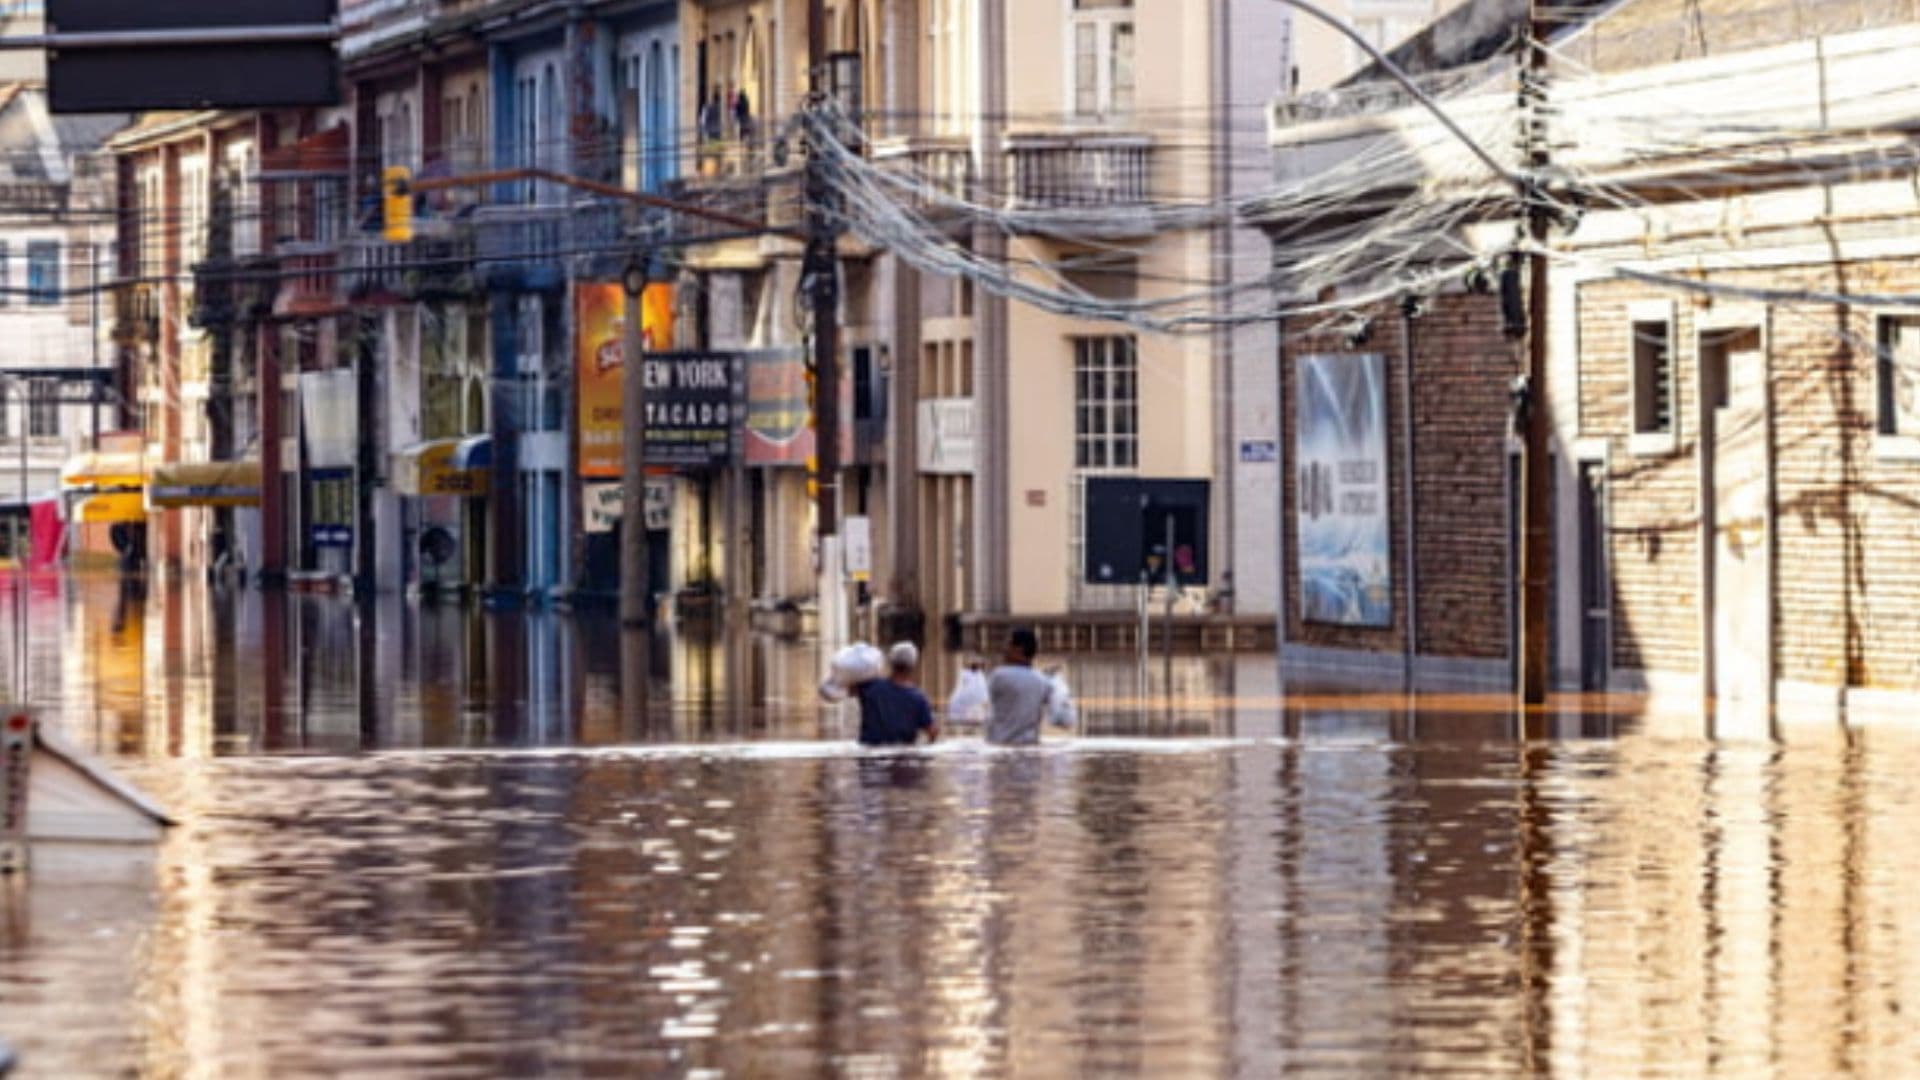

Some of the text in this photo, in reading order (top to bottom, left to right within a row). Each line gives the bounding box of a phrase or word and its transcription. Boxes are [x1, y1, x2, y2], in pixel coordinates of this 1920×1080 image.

[643, 360, 670, 388] EW
[676, 360, 728, 388] YORK
[645, 403, 728, 425] TACADO
